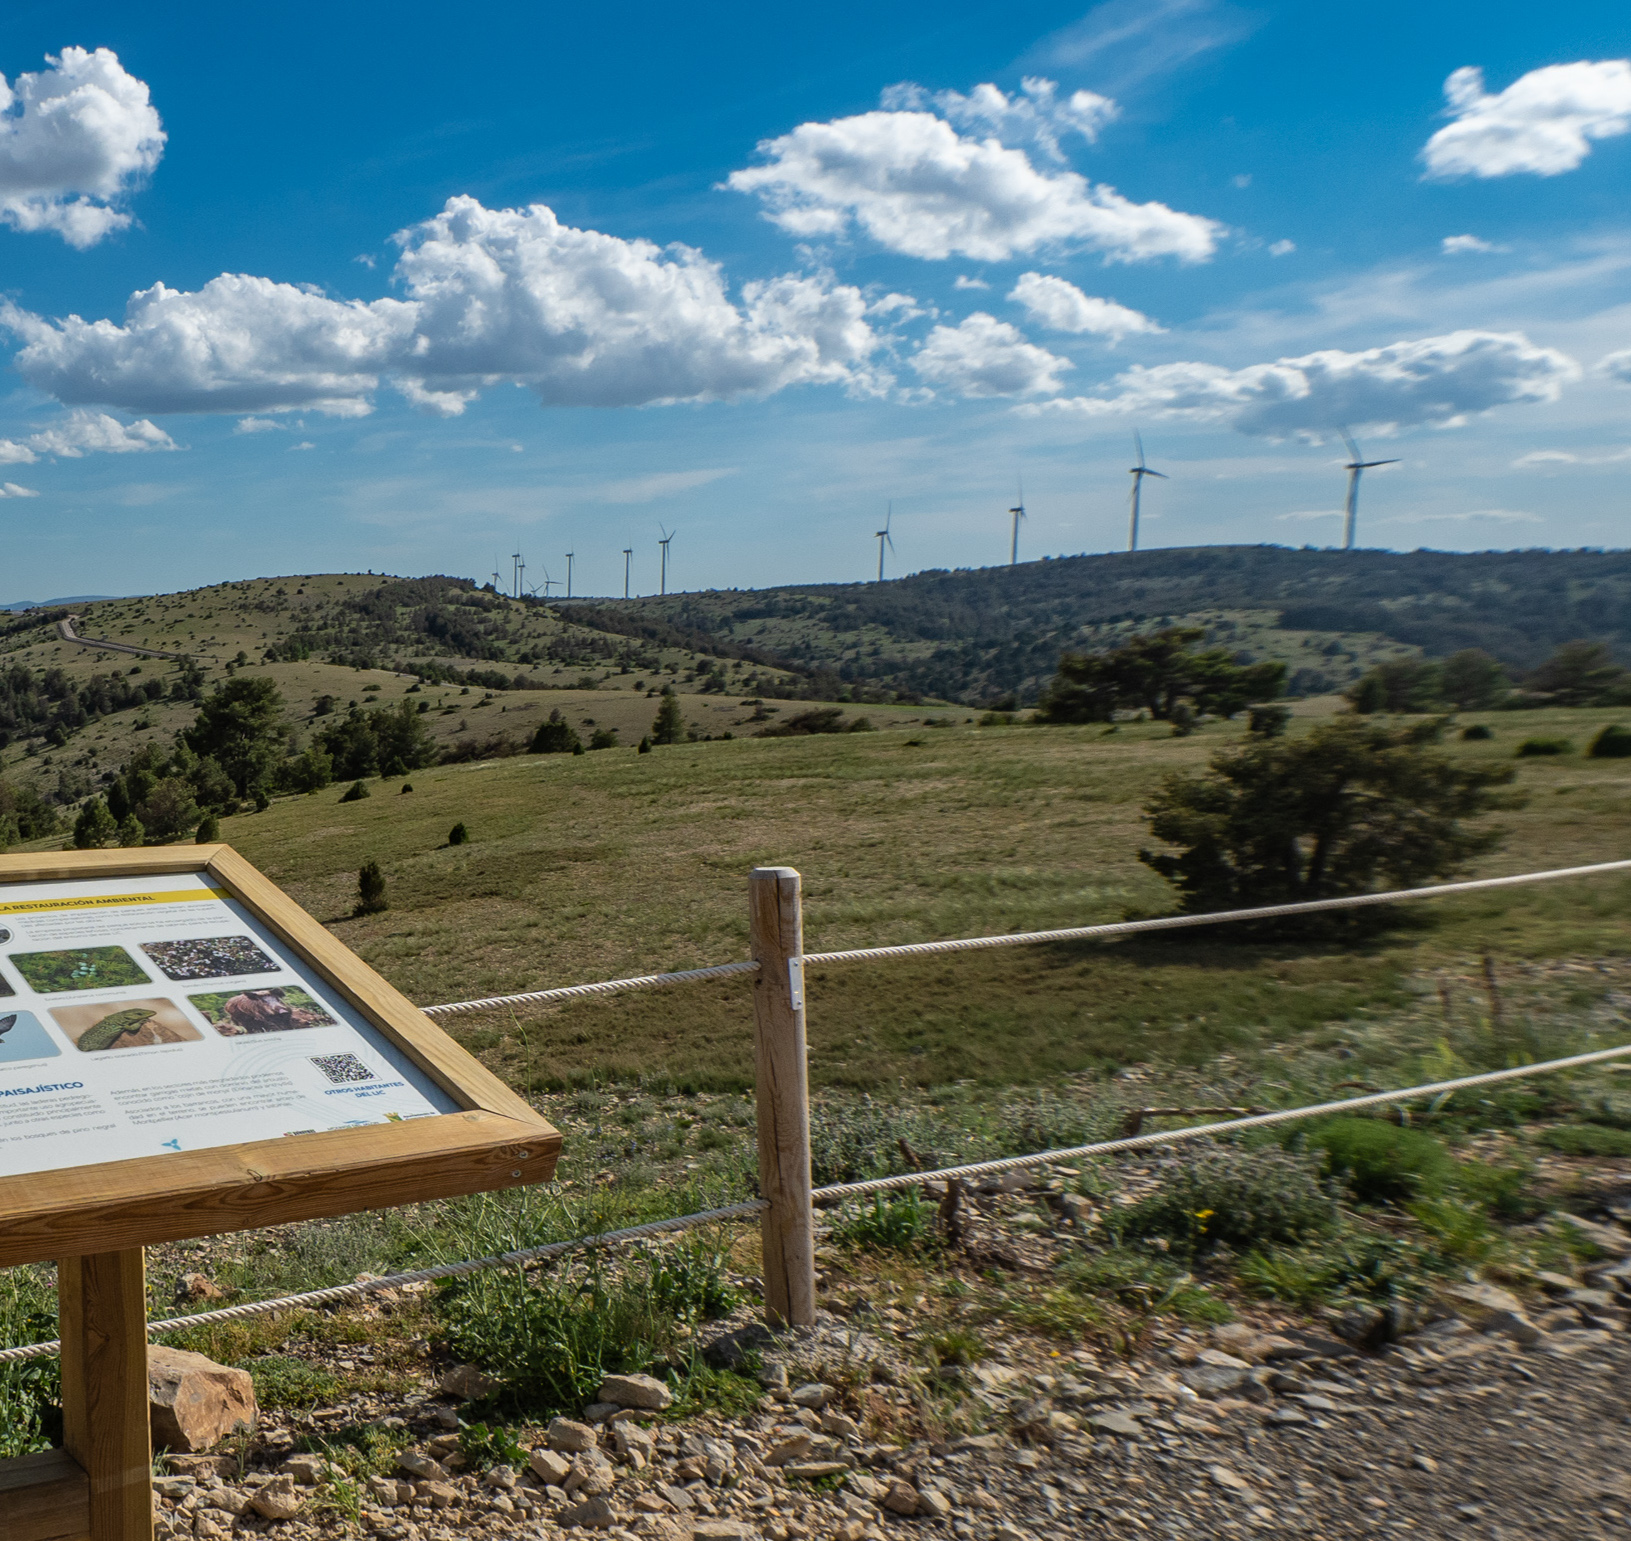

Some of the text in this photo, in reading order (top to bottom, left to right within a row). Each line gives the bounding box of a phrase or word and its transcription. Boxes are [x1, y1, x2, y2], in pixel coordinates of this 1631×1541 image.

[11, 900, 95, 910] RESTAURACIÓN
[95, 896, 156, 905] AMBIENTAL
[324, 1082, 405, 1096] OTROS HABITANTES
